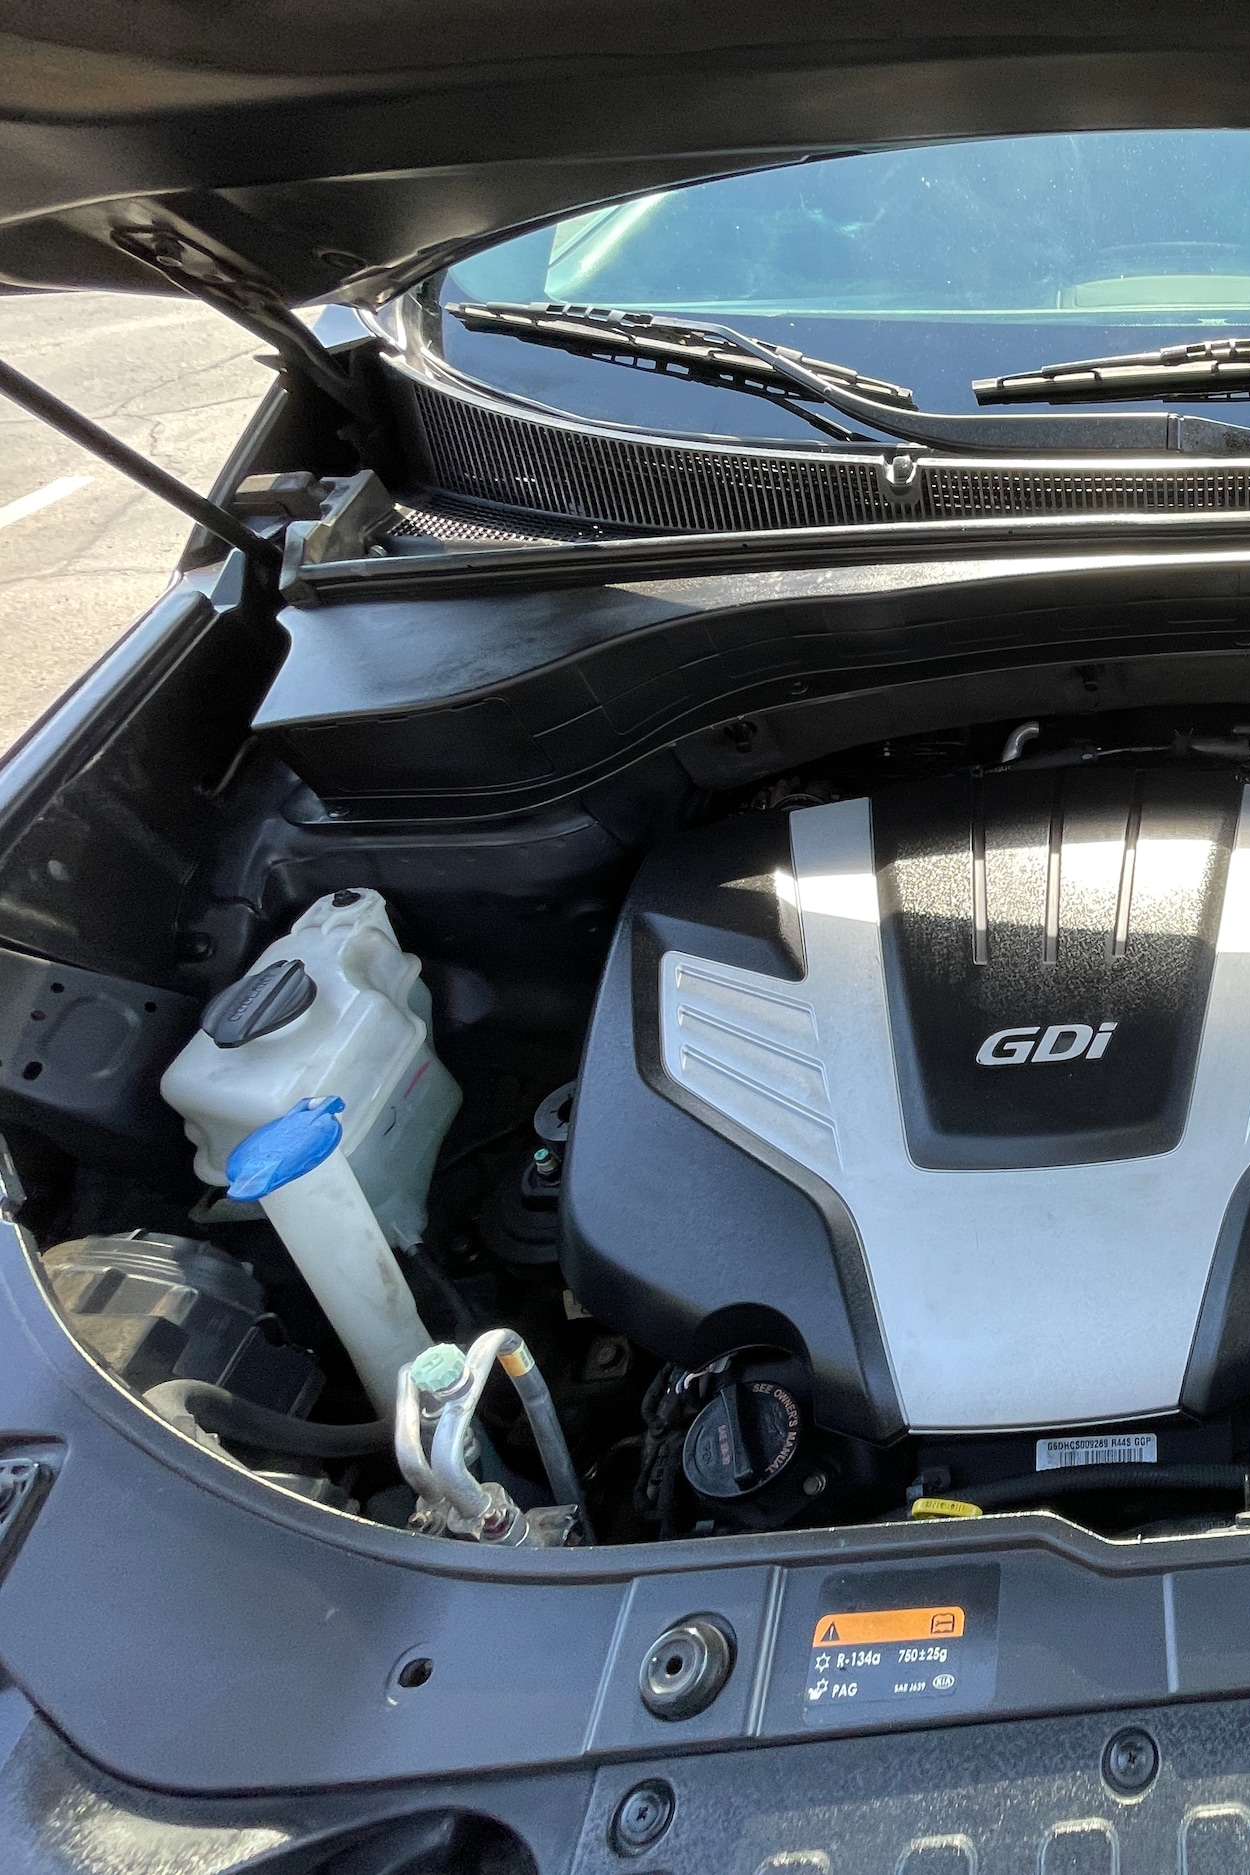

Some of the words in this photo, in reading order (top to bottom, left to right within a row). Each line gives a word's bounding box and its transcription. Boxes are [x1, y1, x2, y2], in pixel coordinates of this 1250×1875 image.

[975, 1022, 1119, 1066] GDi
[752, 1383, 774, 1395] SEE
[773, 1388, 799, 1428] OWNER'S
[764, 1431, 798, 1474] MANUAL
[831, 1682, 858, 1698] PAG
